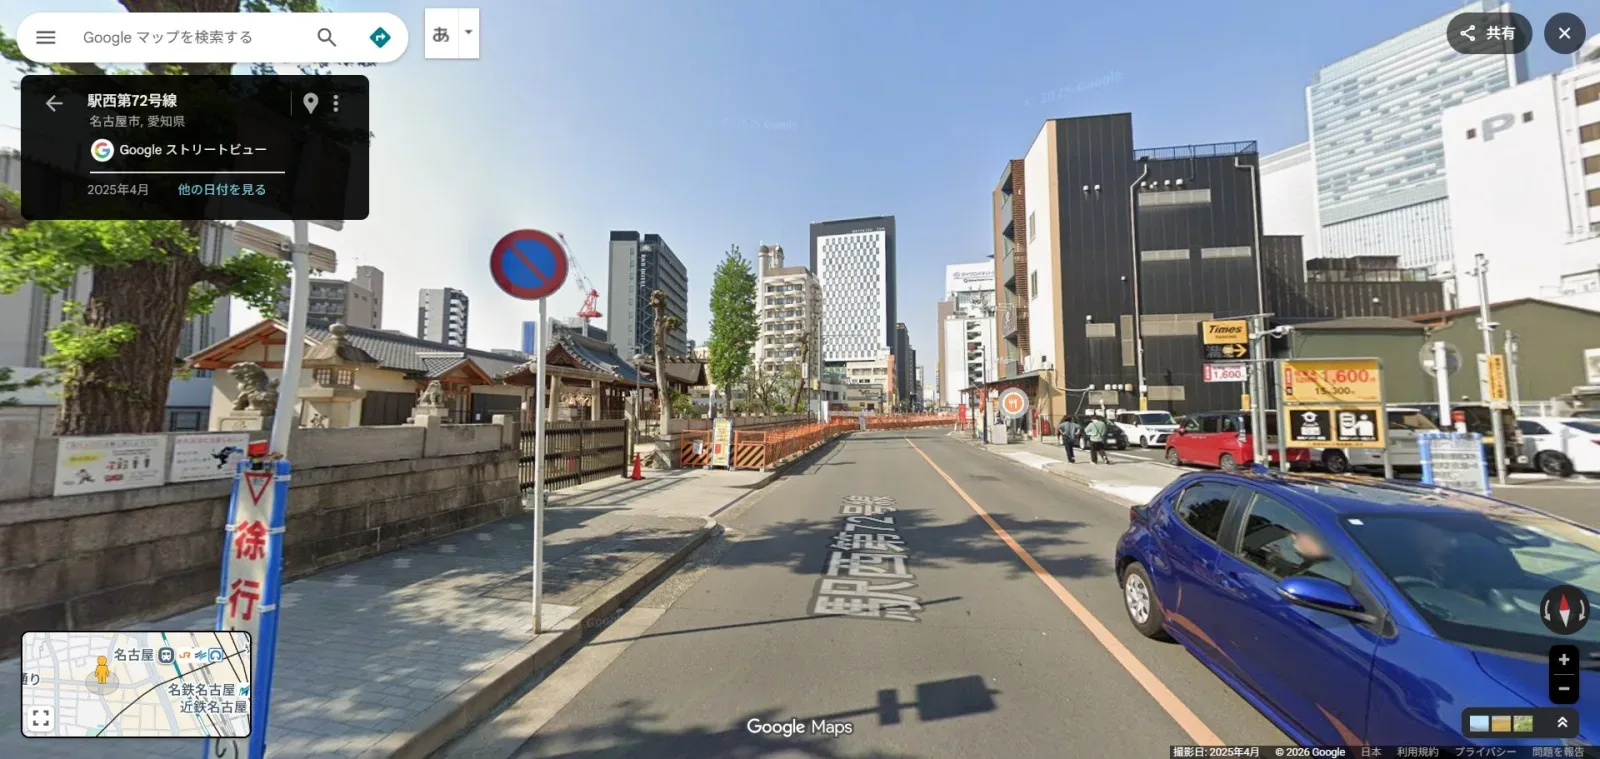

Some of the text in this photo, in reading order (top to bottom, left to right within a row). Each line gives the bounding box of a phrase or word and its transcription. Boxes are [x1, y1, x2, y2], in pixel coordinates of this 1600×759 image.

[1482, 113, 1515, 142] P
[1209, 325, 1242, 333] Times
[228, 520, 267, 621] 徐行
